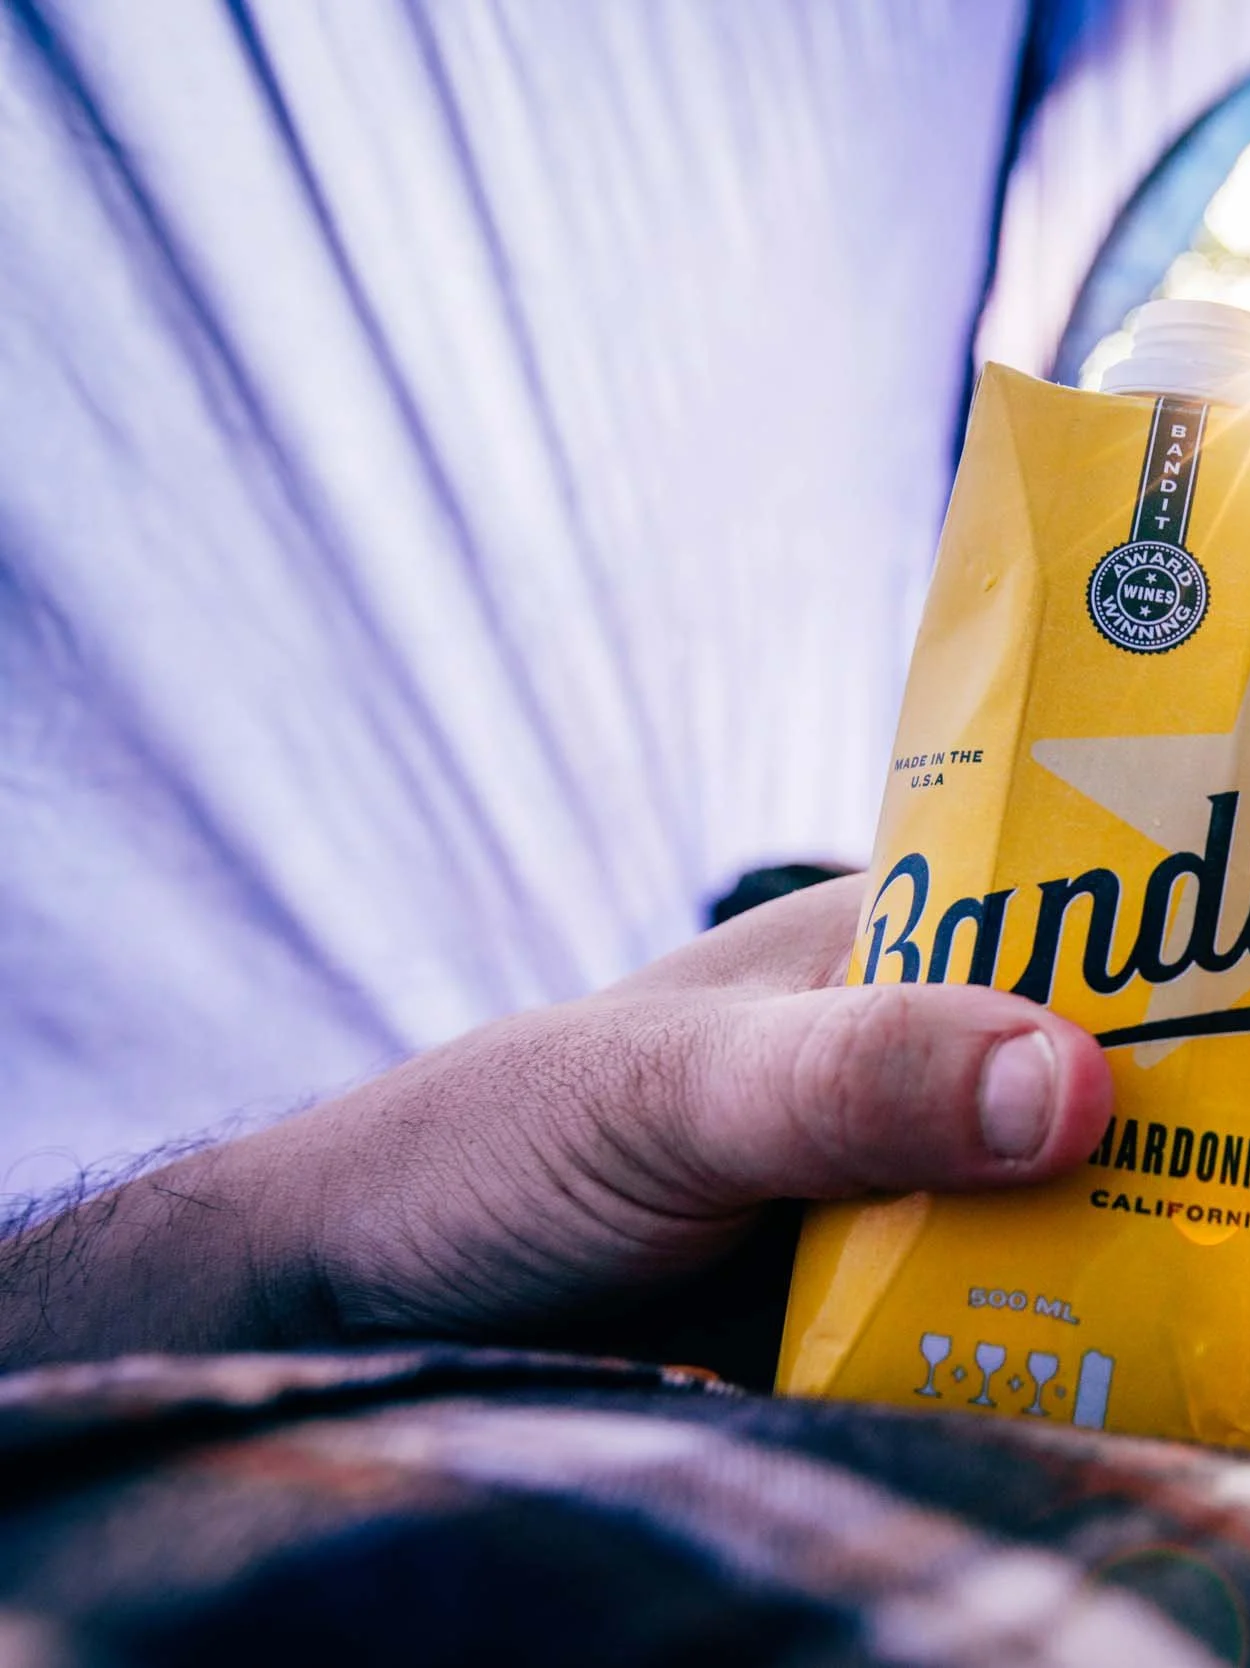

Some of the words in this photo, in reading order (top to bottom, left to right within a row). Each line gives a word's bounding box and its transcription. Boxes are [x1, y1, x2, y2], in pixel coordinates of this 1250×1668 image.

[1155, 424, 1187, 531] BANDIT
[1112, 550, 1194, 588] AWARD
[1123, 584, 1175, 605] WINES
[1102, 595, 1193, 640] WINNING
[894, 755, 928, 771] MADE
[930, 752, 945, 765] IN
[950, 750, 984, 763] THE
[911, 773, 944, 788] U.S.A
[968, 1287, 1026, 1311] 500
